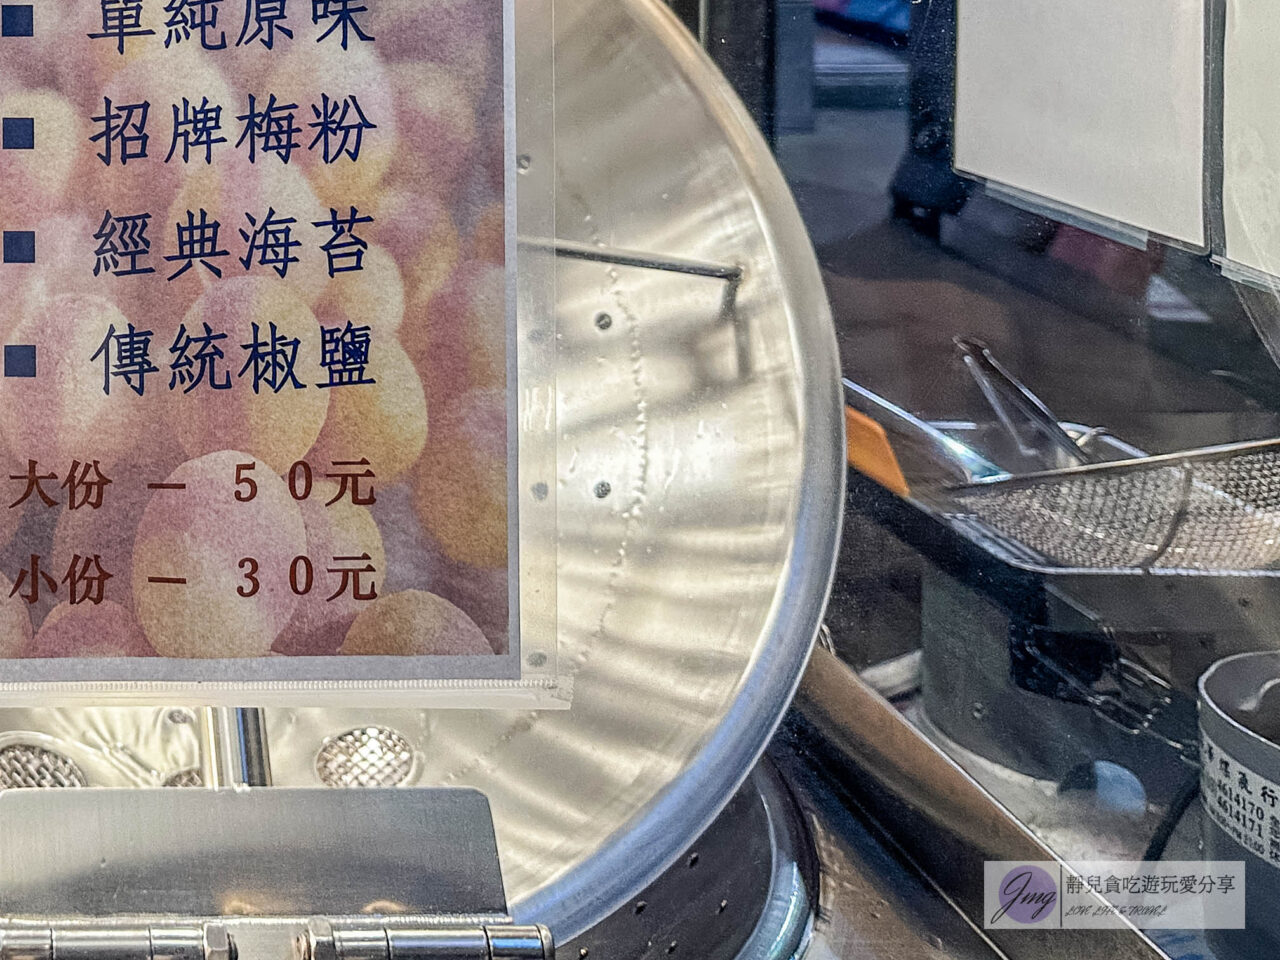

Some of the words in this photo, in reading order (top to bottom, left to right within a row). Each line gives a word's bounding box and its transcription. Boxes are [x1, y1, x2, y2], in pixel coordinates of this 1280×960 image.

[88, 91, 378, 167] 招牌梅粉
[92, 205, 375, 282] 經典海苔
[89, 319, 378, 397] 傳統椒鹽
